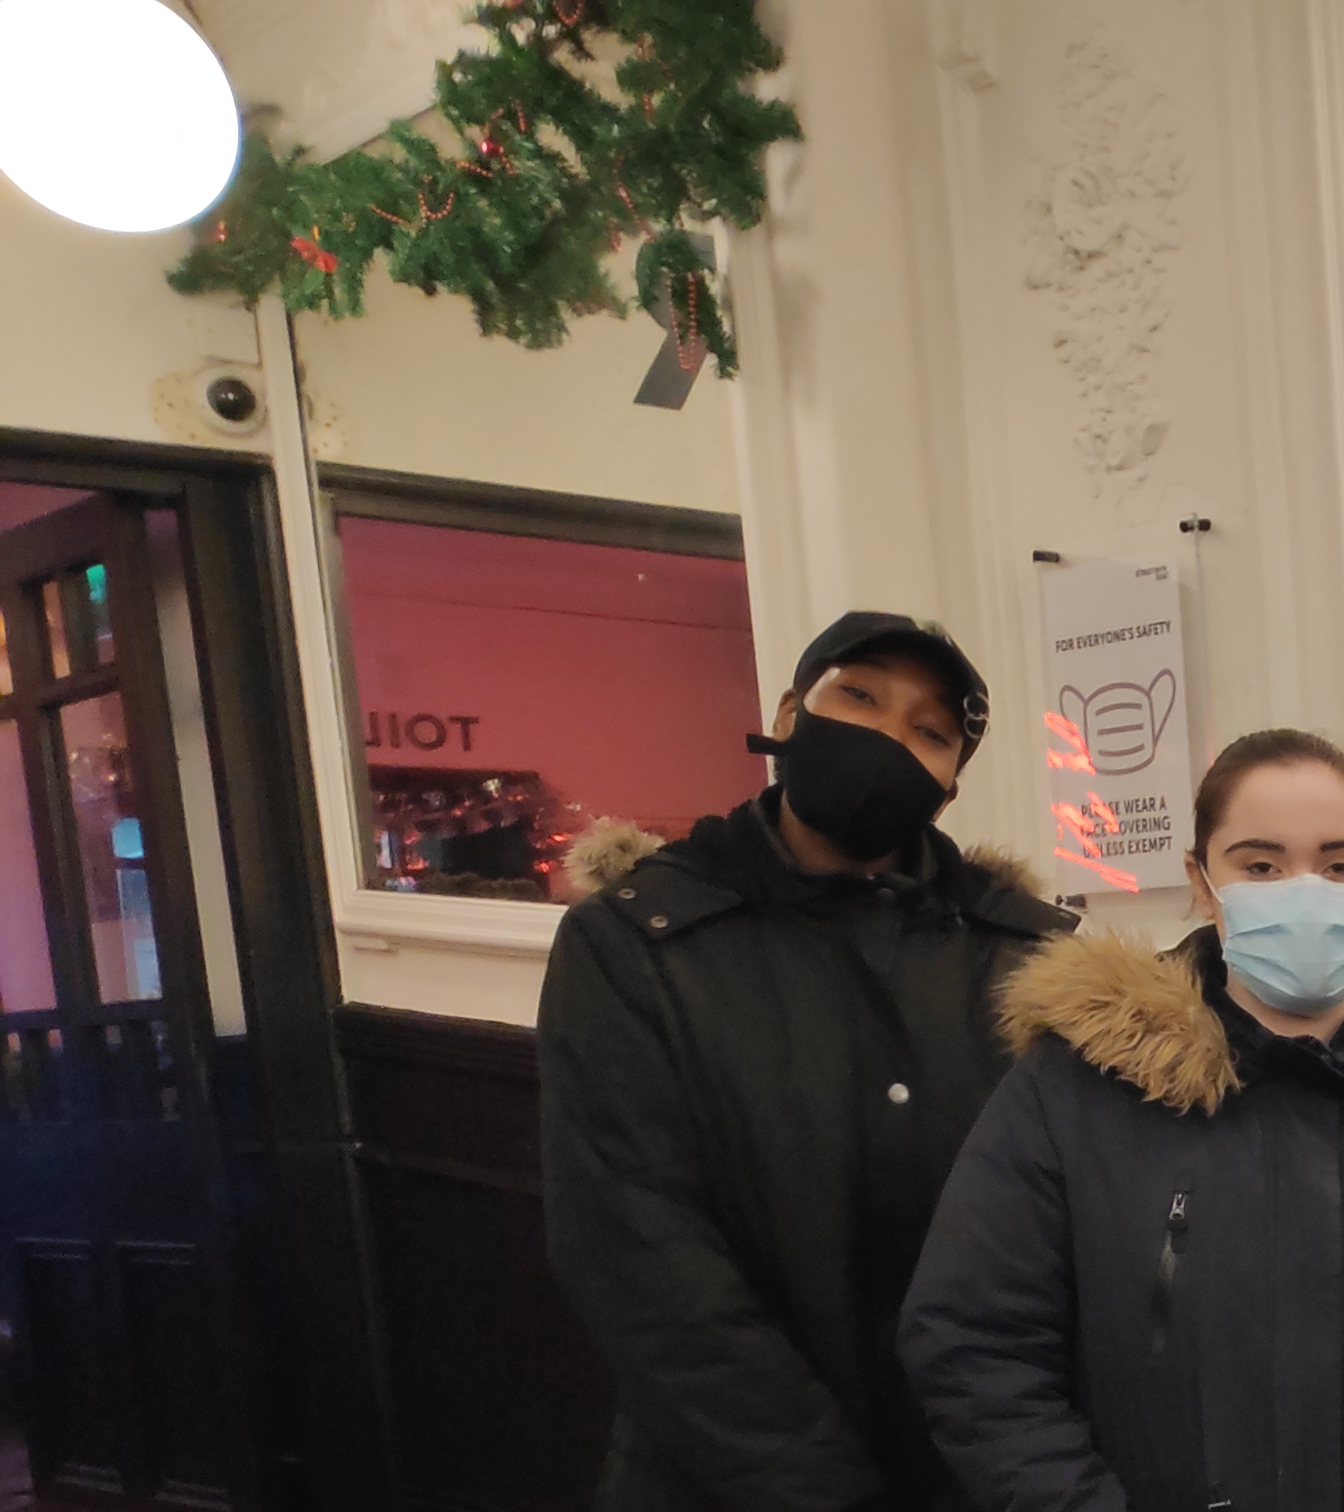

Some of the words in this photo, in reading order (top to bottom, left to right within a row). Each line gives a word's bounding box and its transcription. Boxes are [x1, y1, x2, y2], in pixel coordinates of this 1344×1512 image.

[1055, 638, 1075, 653] FOR
[1136, 620, 1171, 639] SAFETY
[1123, 797, 1156, 816] WEAR
[1159, 795, 1168, 812] A
[1113, 815, 1171, 837] OVERING
[1083, 841, 1125, 859] ULESS
[1127, 836, 1172, 855] EXEMPT
